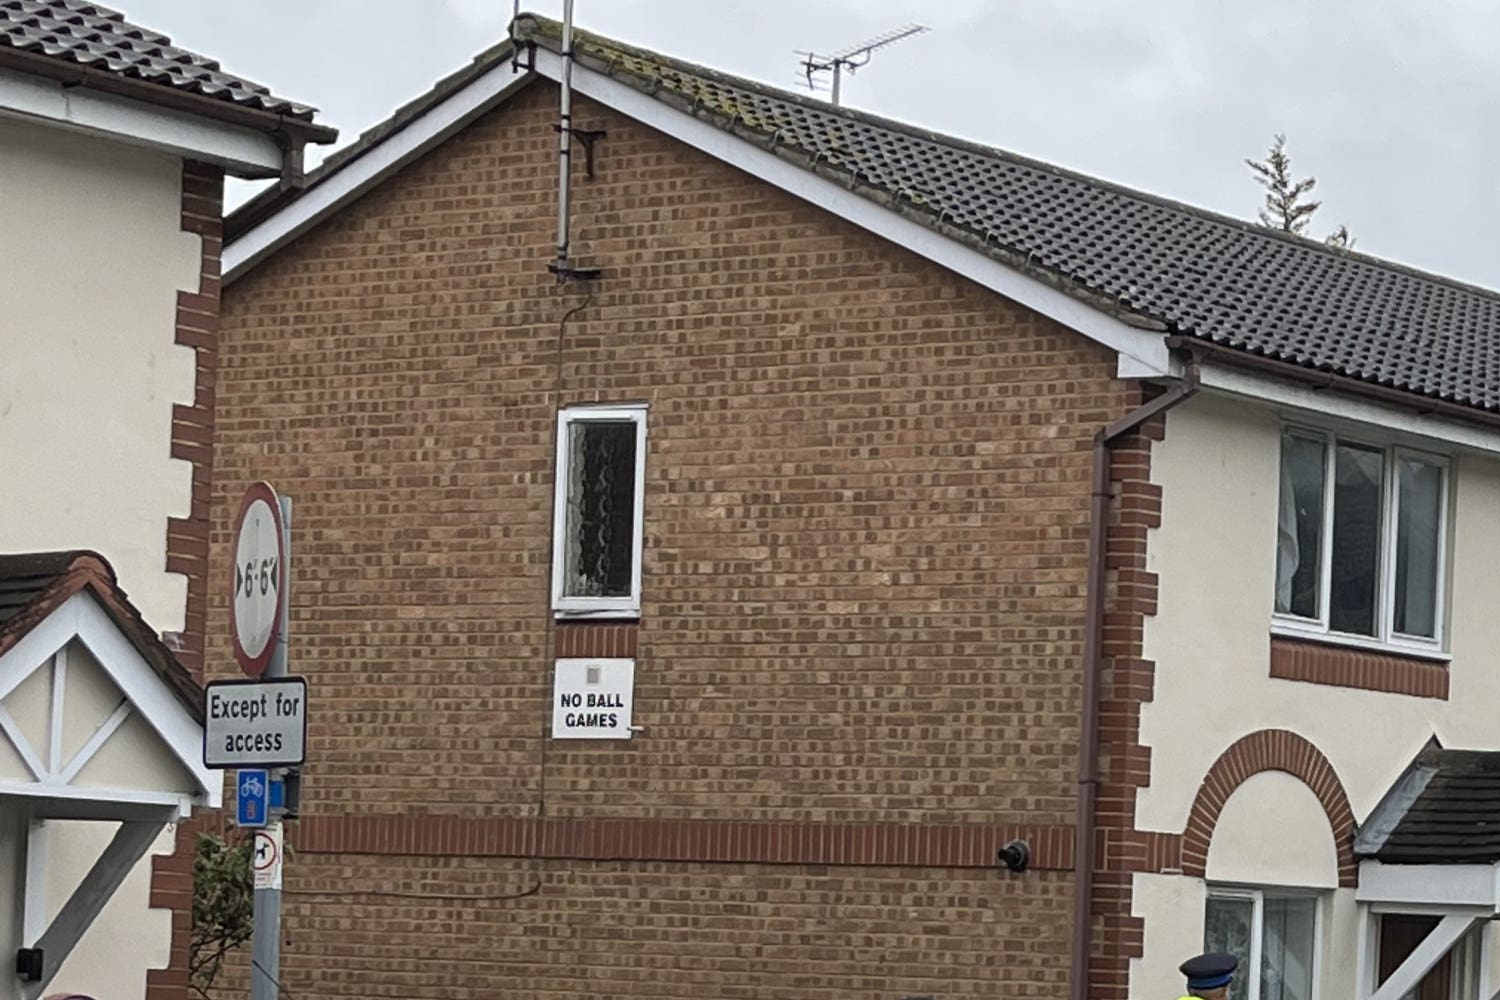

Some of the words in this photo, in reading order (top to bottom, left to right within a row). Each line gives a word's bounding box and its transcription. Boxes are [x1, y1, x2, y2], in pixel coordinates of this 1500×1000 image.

[211, 693, 267, 722] Except
[276, 692, 299, 716] for
[561, 693, 582, 707] NO
[587, 693, 624, 707] BALL
[565, 712, 617, 728] GAMES
[225, 733, 282, 752] access
